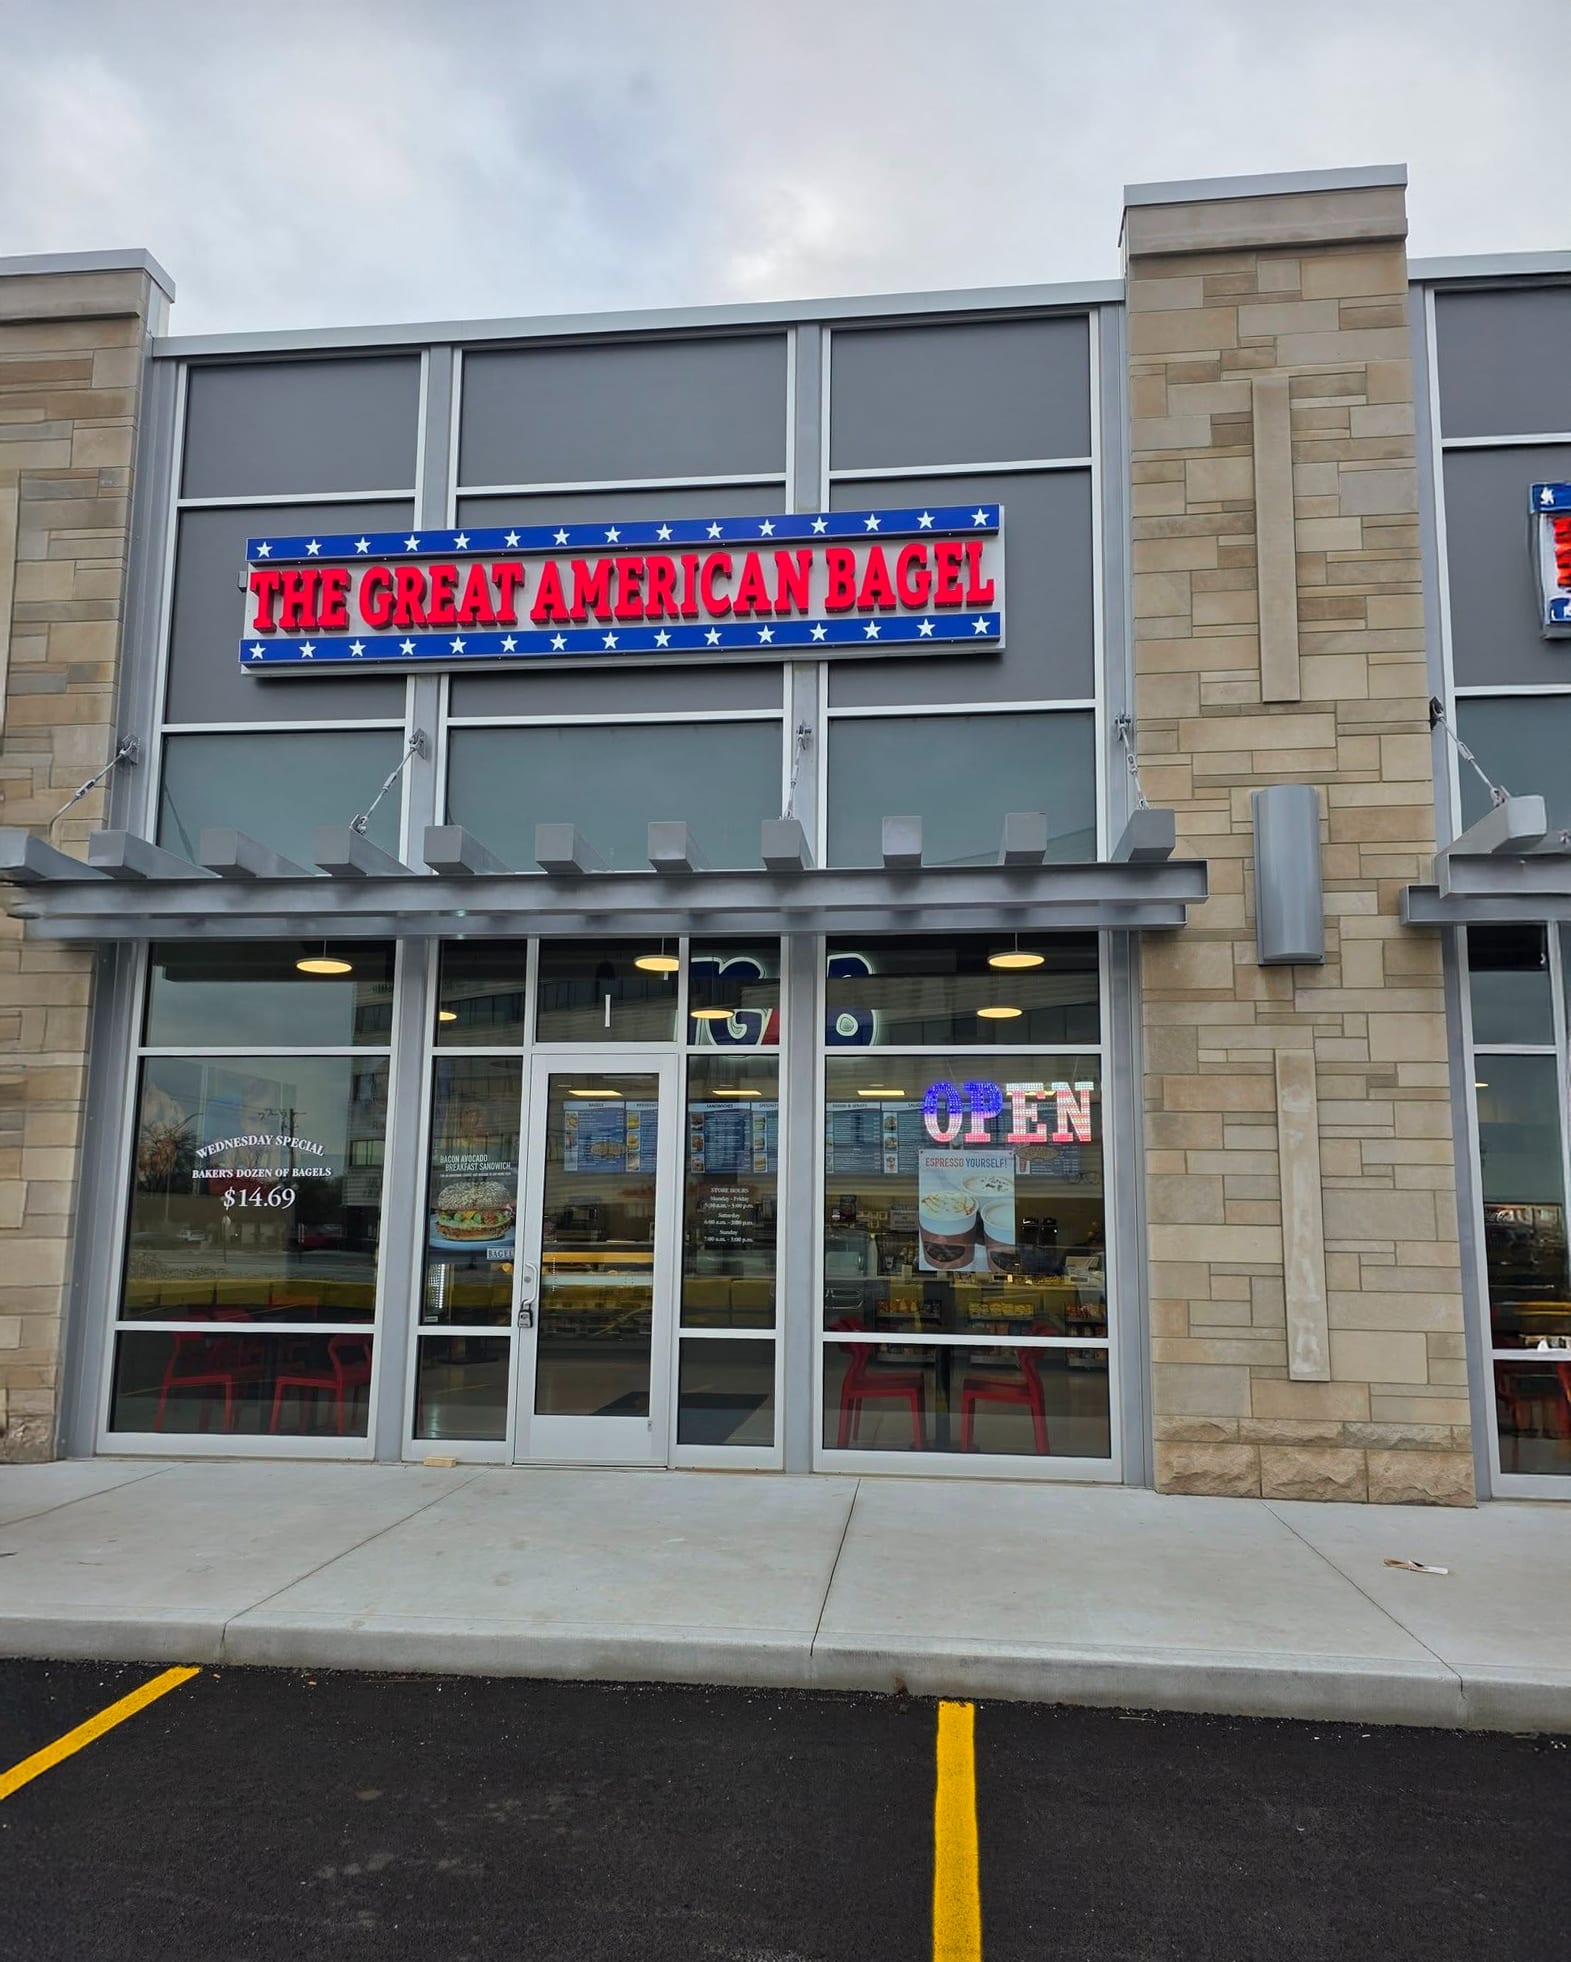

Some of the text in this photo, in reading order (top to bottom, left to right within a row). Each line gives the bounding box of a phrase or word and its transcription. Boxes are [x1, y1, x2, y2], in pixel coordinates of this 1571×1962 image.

[250, 541, 995, 633] THE GREAT AMERICAN BAGEL
[923, 1081, 1094, 1143] OPEN
[196, 1135, 325, 1158] WEDNESDAY SPECIAL
[440, 1154, 488, 1163] BACON AVOCADO
[445, 1162, 478, 1172] BREAKFAST
[925, 1157, 1008, 1168] ESPRESSO YOURSELF!
[192, 1168, 332, 1179] BAKER'S DOZEN OF BAGELS
[223, 1185, 296, 1210] $14.69
